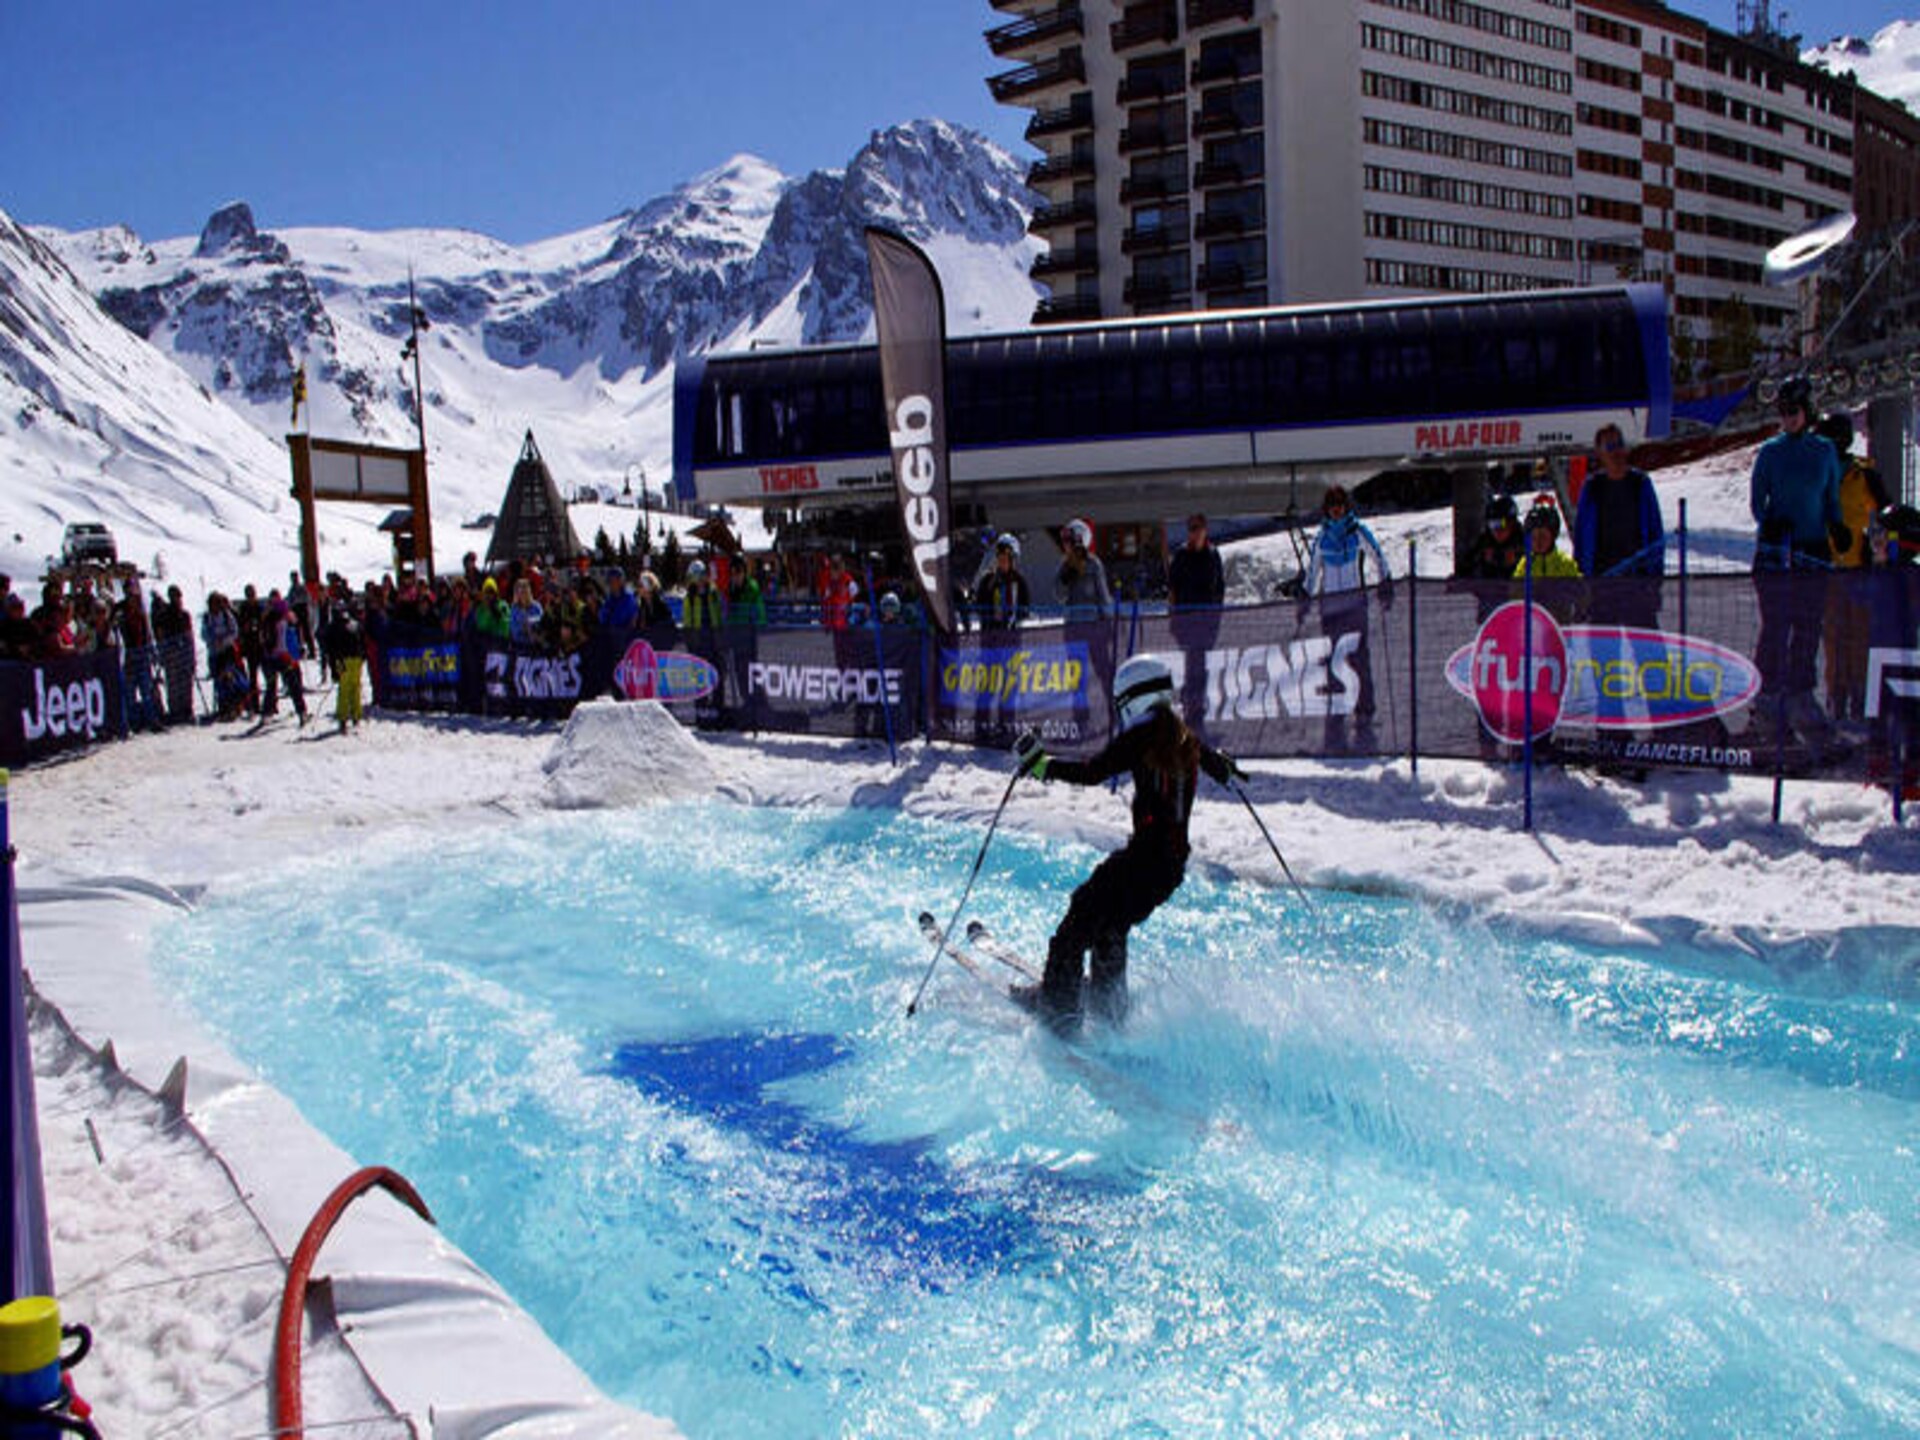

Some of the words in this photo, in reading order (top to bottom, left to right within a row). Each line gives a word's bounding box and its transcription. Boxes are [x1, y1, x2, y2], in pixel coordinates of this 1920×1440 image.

[1416, 420, 1521, 449] PALAFOUR
[759, 465, 819, 493] TIGNES
[514, 653, 582, 697] TIGNES
[748, 662, 902, 703] POWERADE
[943, 652, 1081, 702] GOODYEAR
[1203, 632, 1361, 721] TIGNES
[1476, 639, 1560, 693] fun
[1571, 651, 1723, 701] radio
[22, 668, 104, 739] Jeep
[1624, 742, 1750, 766] DANCEFLOOR
